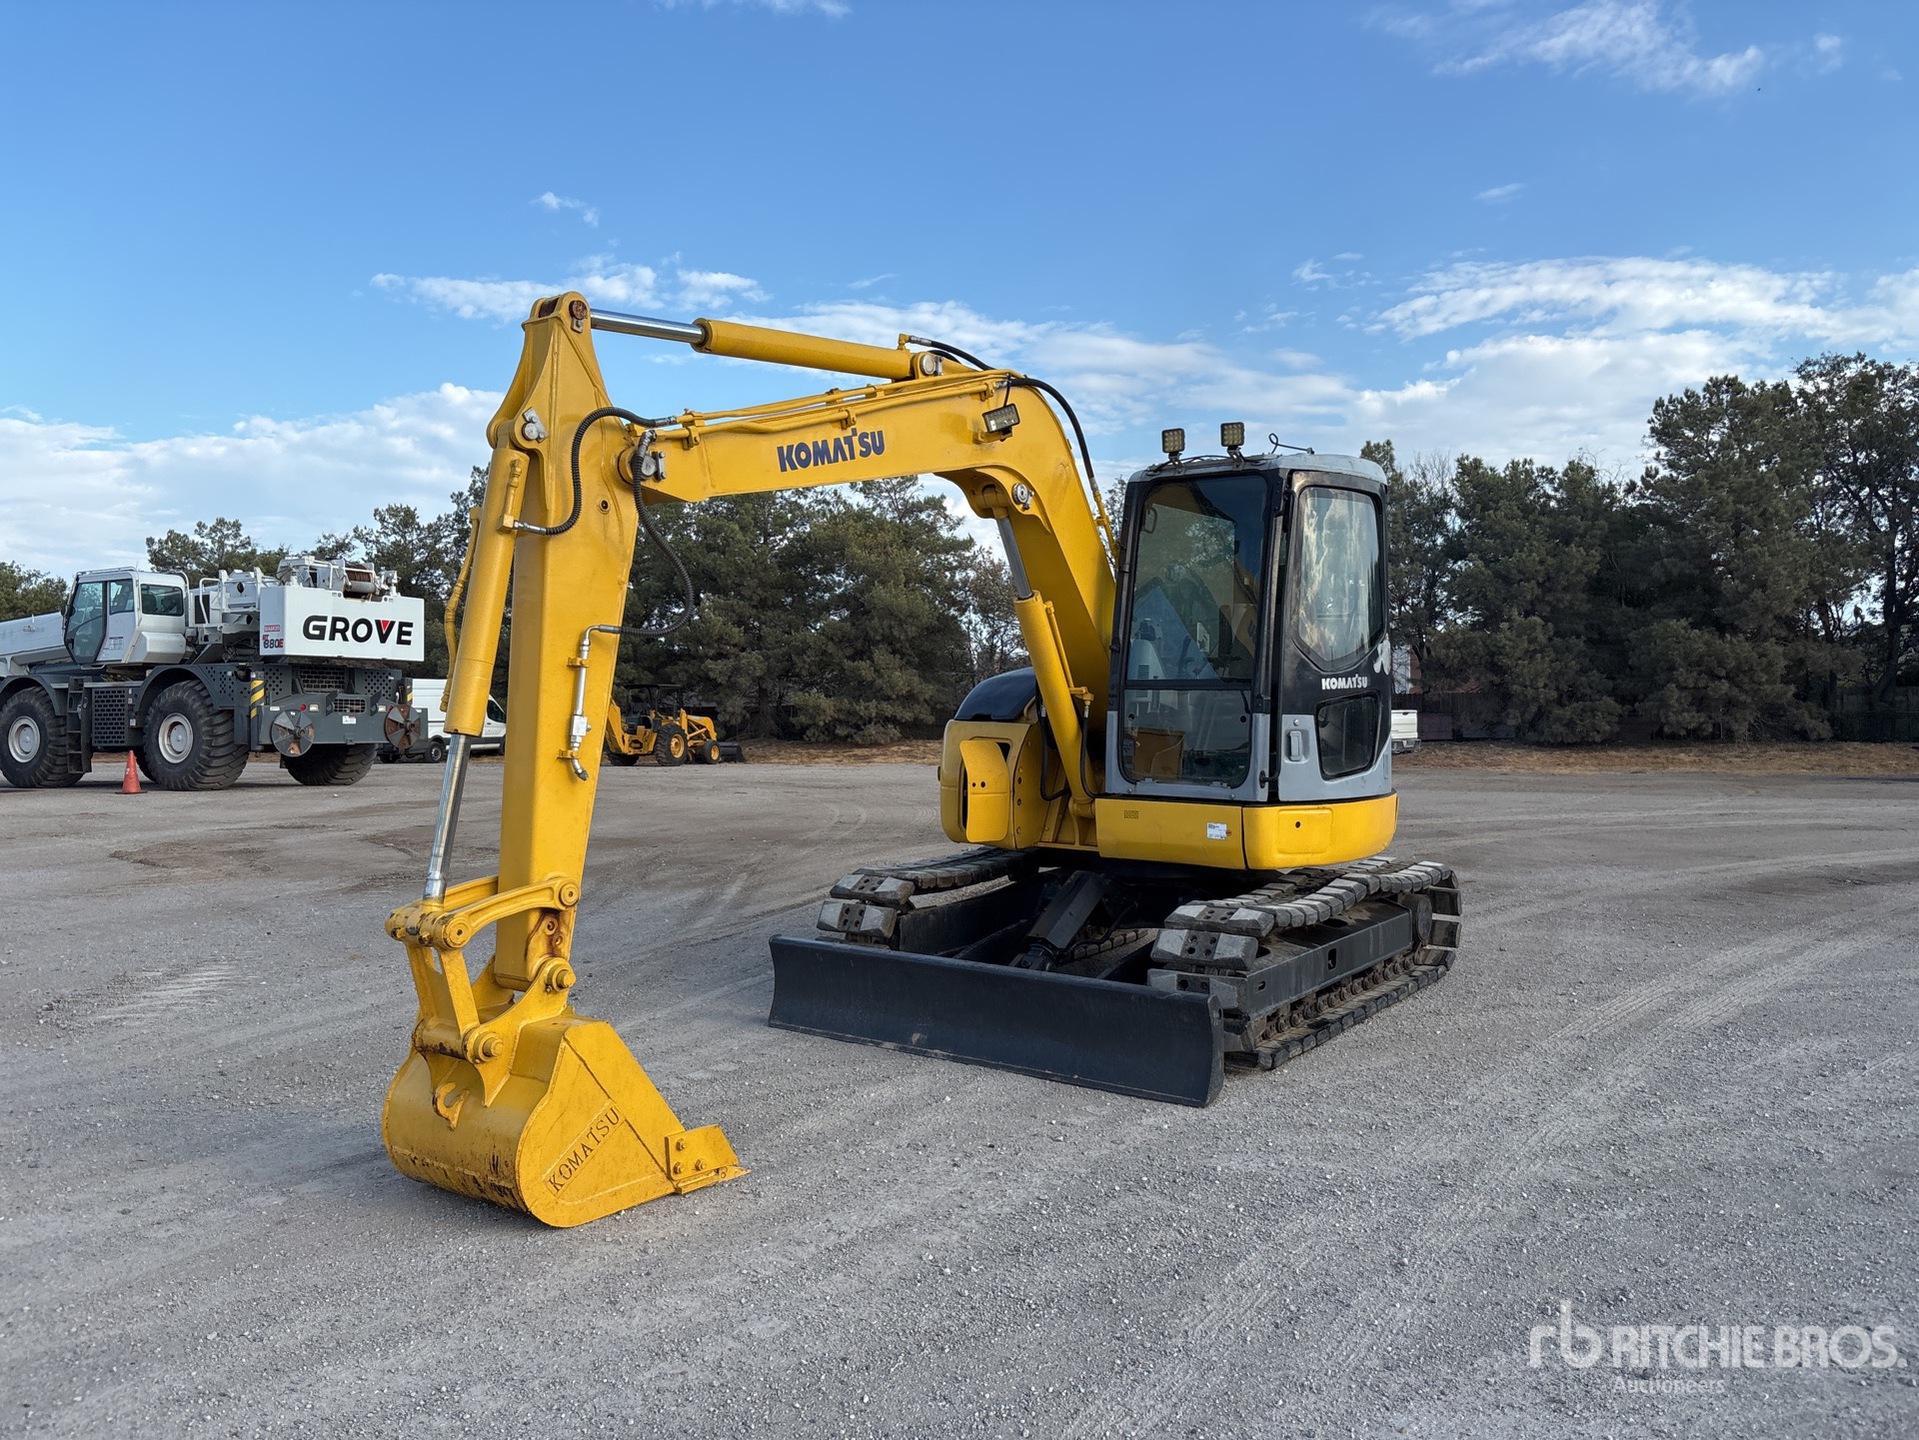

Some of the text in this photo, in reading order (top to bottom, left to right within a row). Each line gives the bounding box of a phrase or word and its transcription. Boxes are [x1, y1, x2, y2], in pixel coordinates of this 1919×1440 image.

[777, 427, 885, 472] KOMATSU
[303, 615, 413, 645] GROVE
[1321, 674, 1368, 690] KOMATSU
[548, 1107, 620, 1193] KOMATSU
